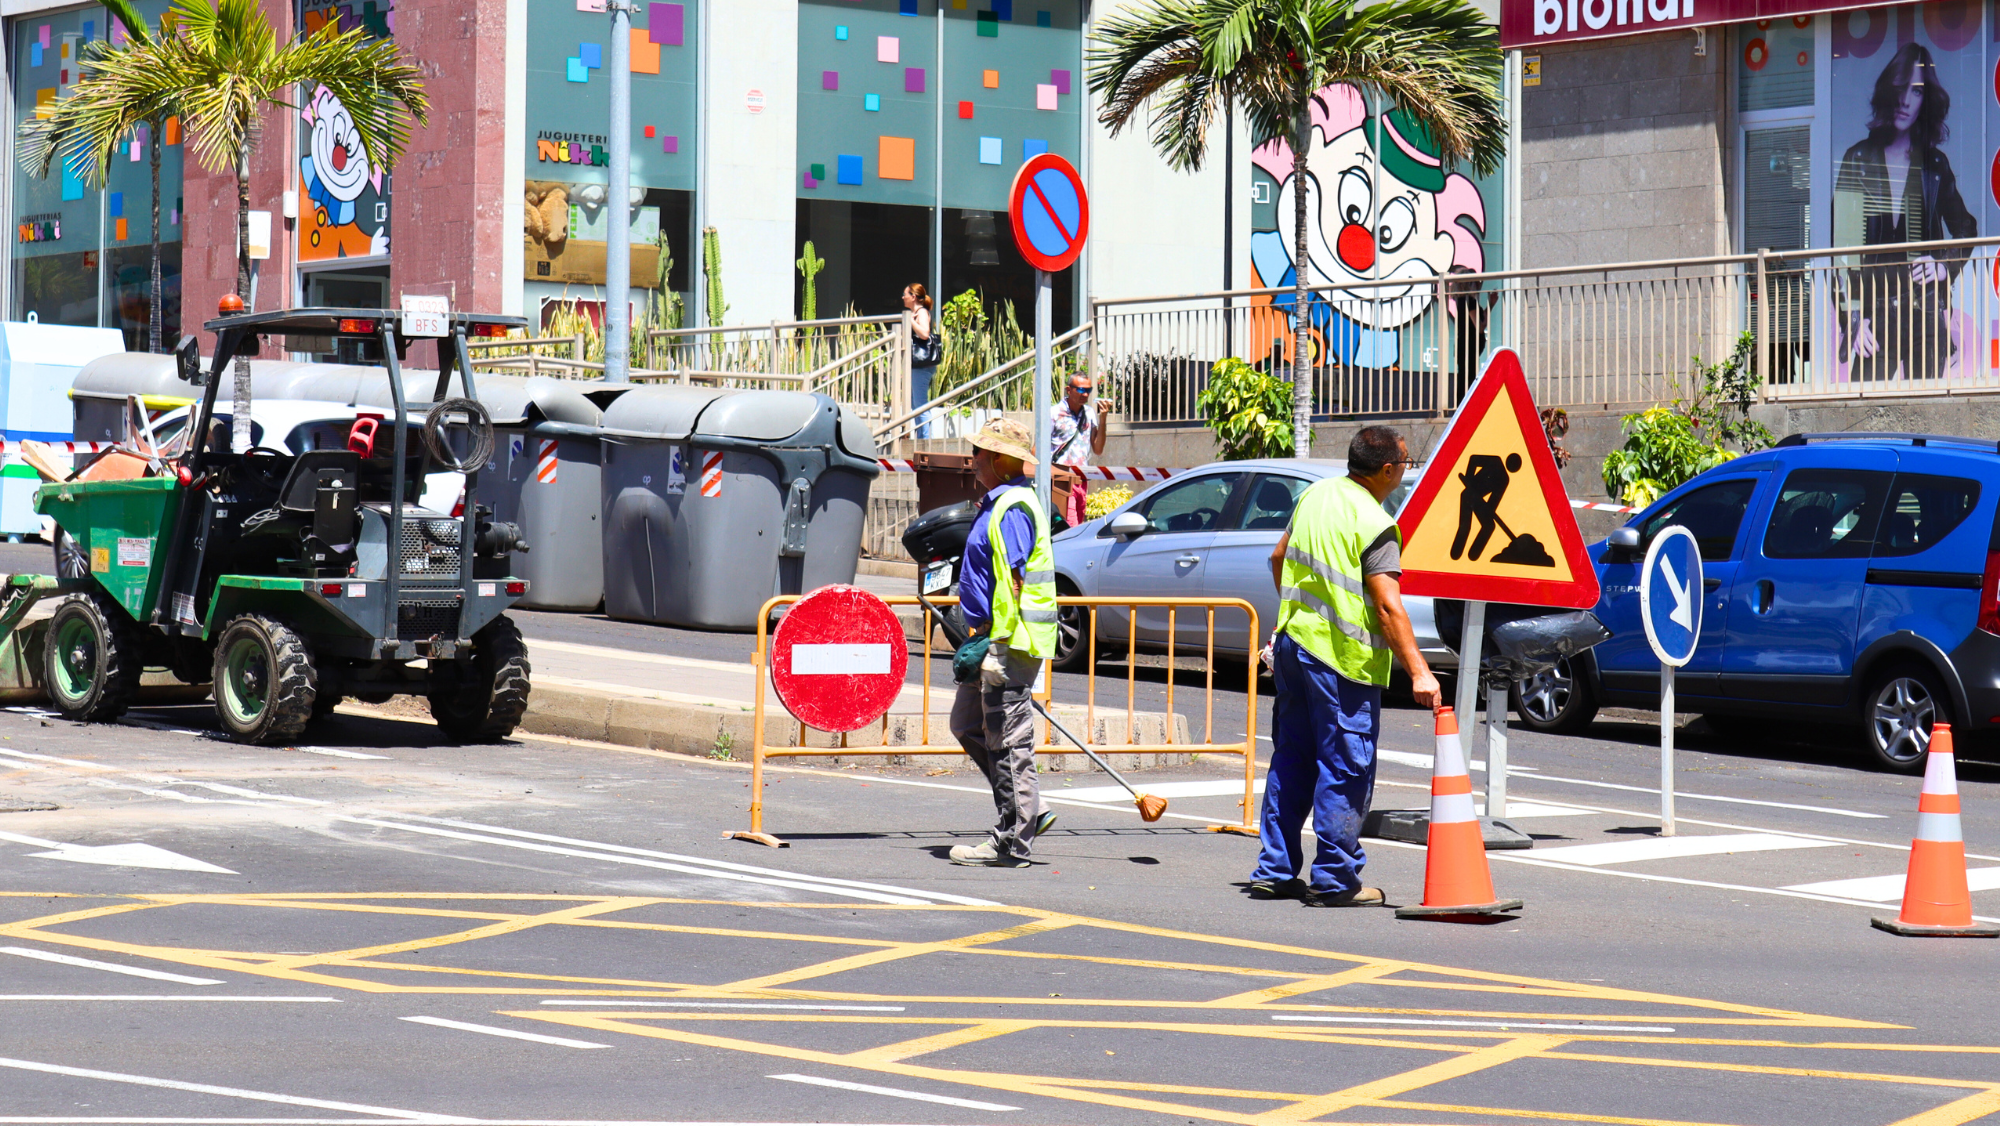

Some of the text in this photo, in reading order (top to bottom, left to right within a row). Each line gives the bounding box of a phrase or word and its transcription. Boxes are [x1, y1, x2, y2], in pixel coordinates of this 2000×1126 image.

[537, 130, 607, 144] JUGUETERI
[537, 140, 609, 167] Nikk
[19, 212, 61, 223] JUGUETERIAS
[18, 219, 61, 243] Nikki
[405, 299, 445, 314] E 0323
[415, 318, 438, 333] BFS
[1606, 585, 1641, 593] STEPW
[124, 587, 143, 610] 17
